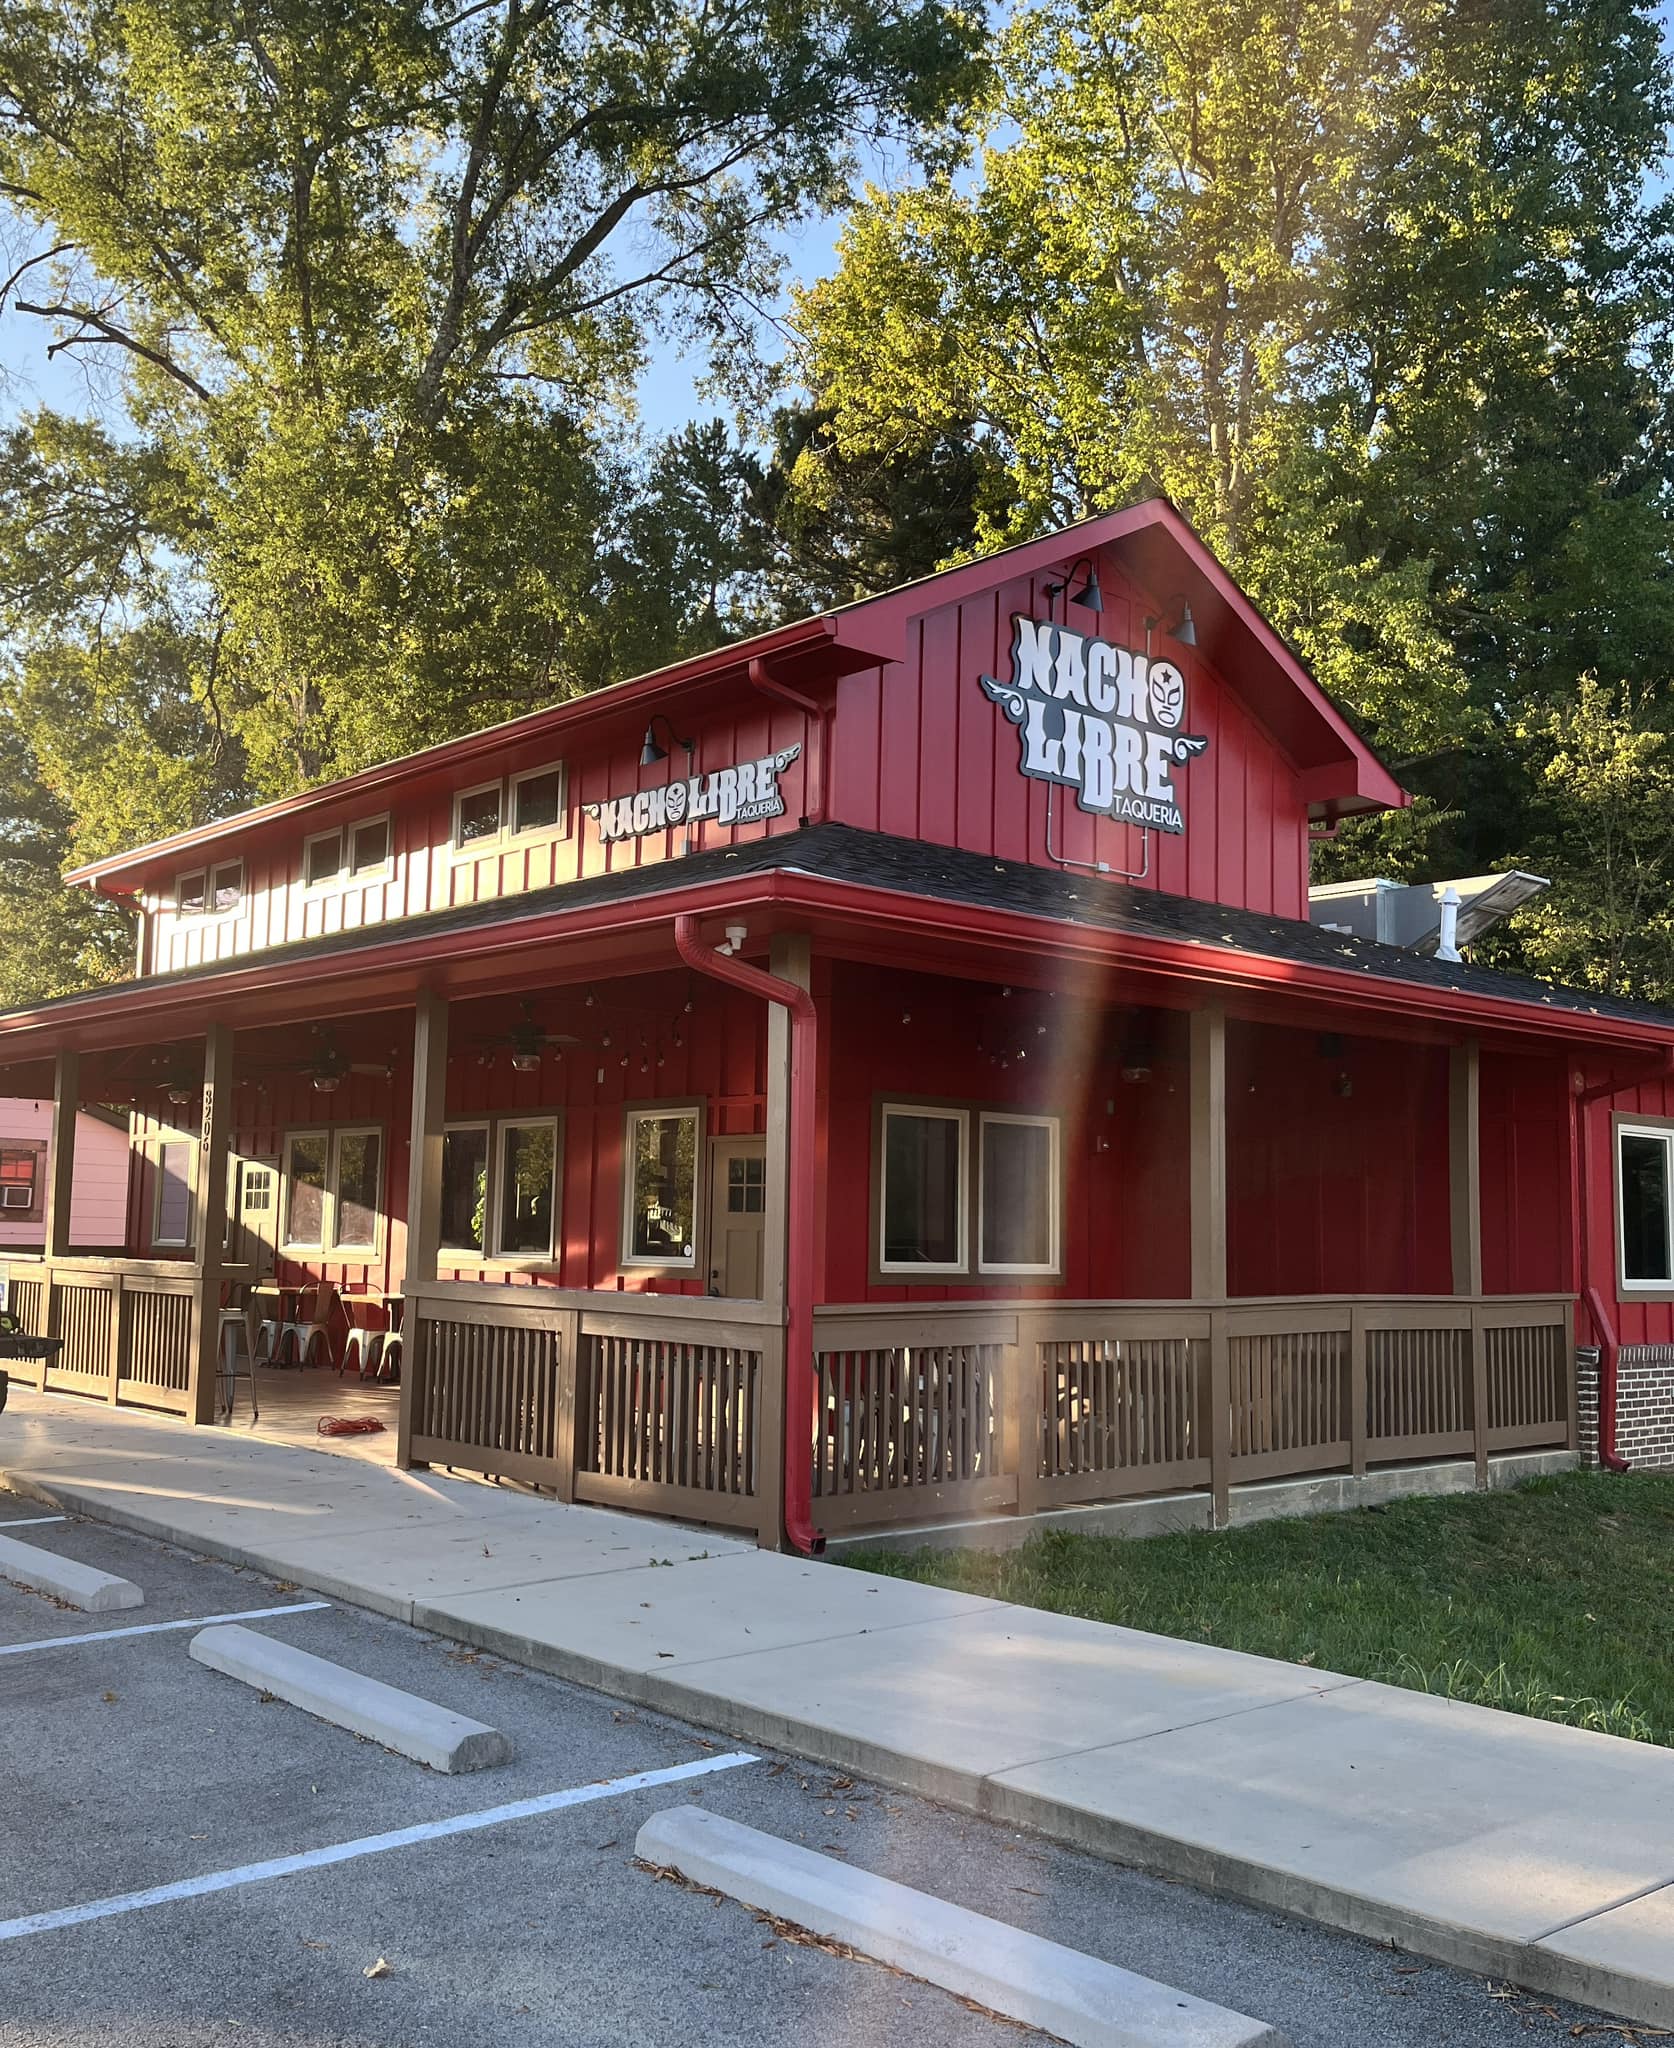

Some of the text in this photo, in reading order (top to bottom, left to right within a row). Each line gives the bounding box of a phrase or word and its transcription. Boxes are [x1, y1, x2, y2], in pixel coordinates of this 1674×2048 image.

[1016, 617, 1185, 728] NACHO
[1025, 698, 1174, 808] LIBRE
[599, 757, 776, 842] NACHO LIBRE
[736, 799, 781, 820] TAQUERIA
[1113, 794, 1184, 829] TAQUERIA
